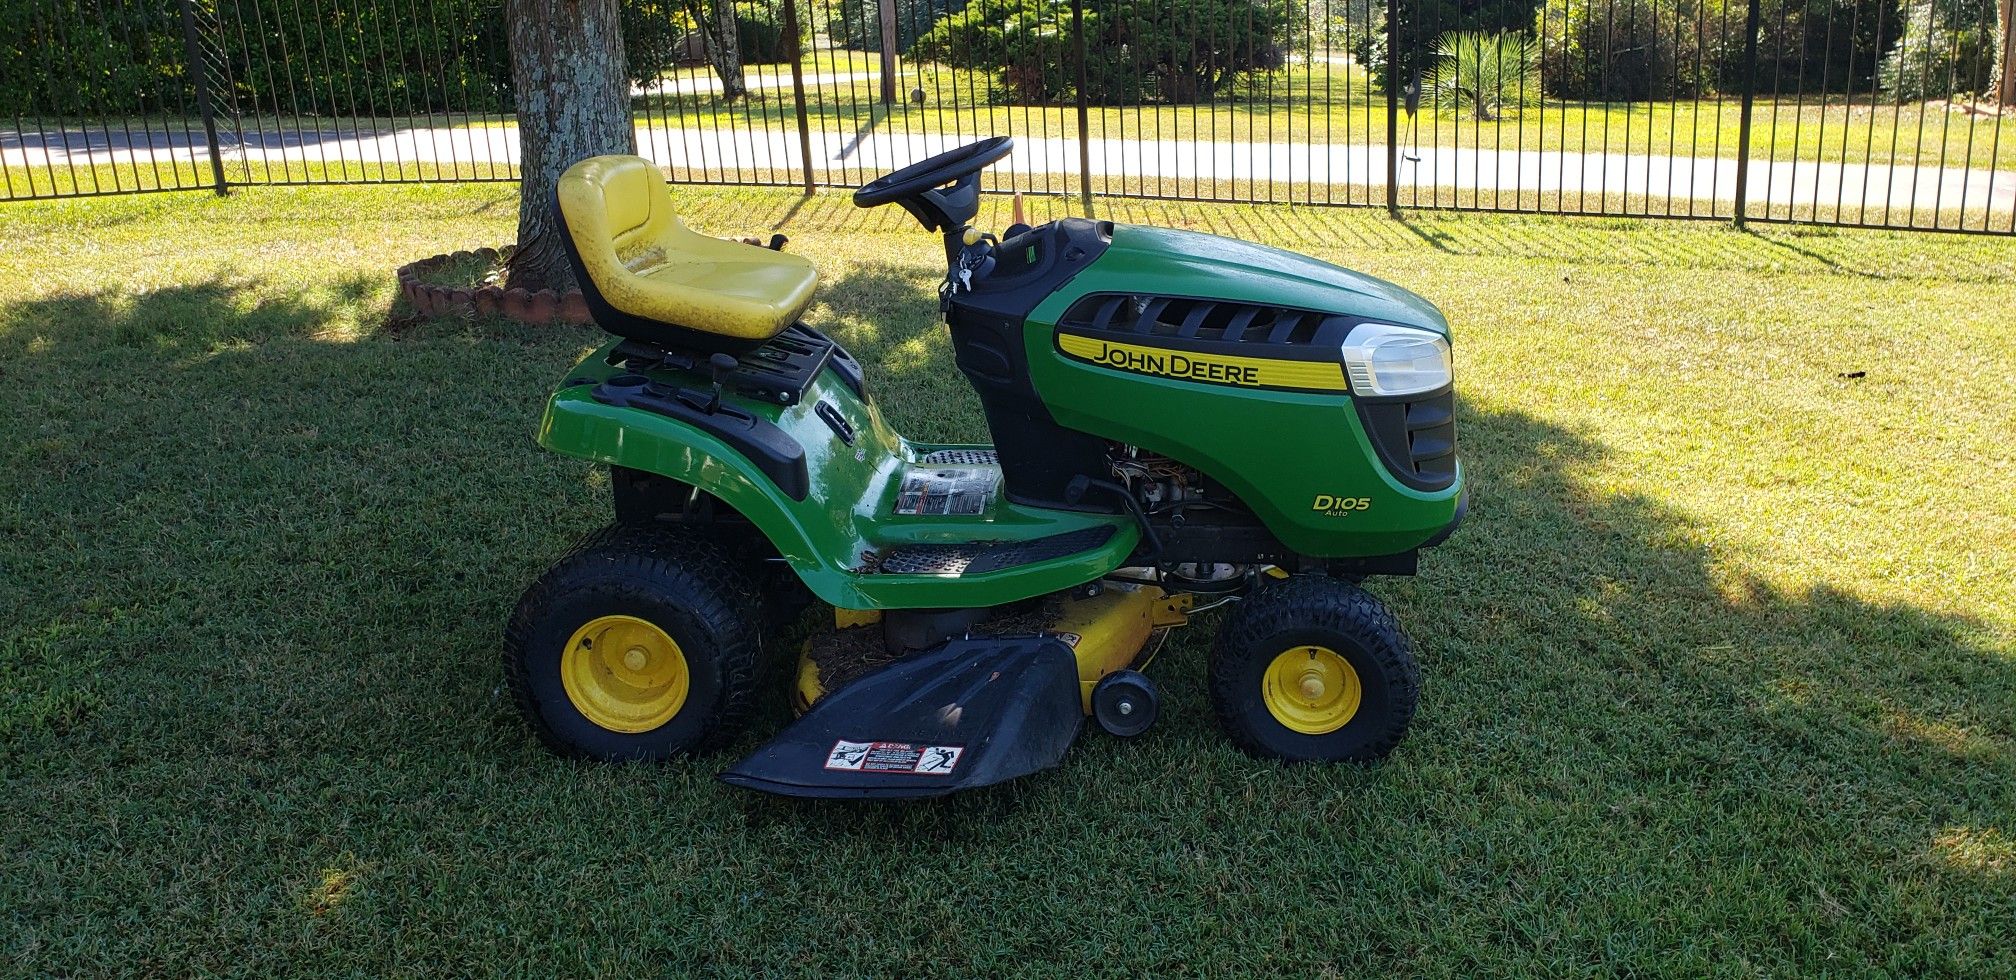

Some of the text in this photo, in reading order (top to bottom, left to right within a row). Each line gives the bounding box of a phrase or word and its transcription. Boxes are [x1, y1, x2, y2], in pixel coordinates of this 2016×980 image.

[1094, 343, 1259, 383] JOHN DEERE
[1313, 495, 1371, 510] D105
